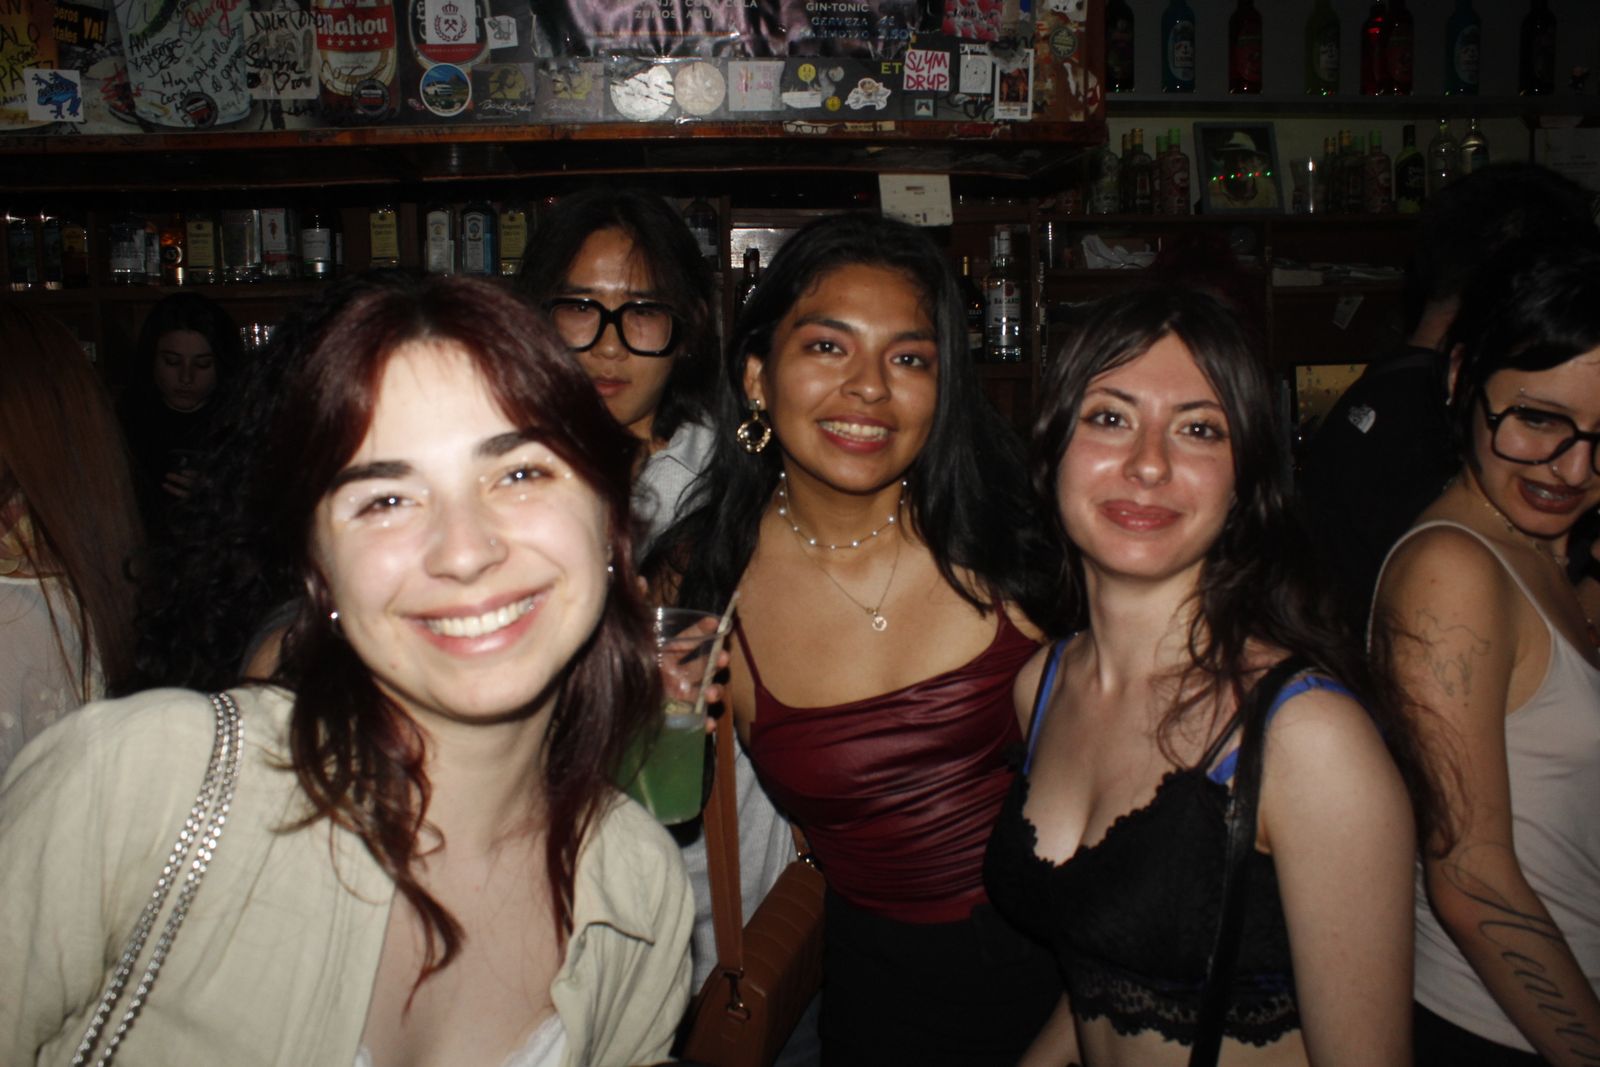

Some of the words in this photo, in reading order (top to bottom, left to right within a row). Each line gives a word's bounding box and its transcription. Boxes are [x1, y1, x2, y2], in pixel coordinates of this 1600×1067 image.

[635, 10, 678, 18] ZUMOS
[806, 2, 869, 12] GIN-TONIC
[319, 13, 388, 35] Mahou
[906, 50, 947, 73] SLYM
